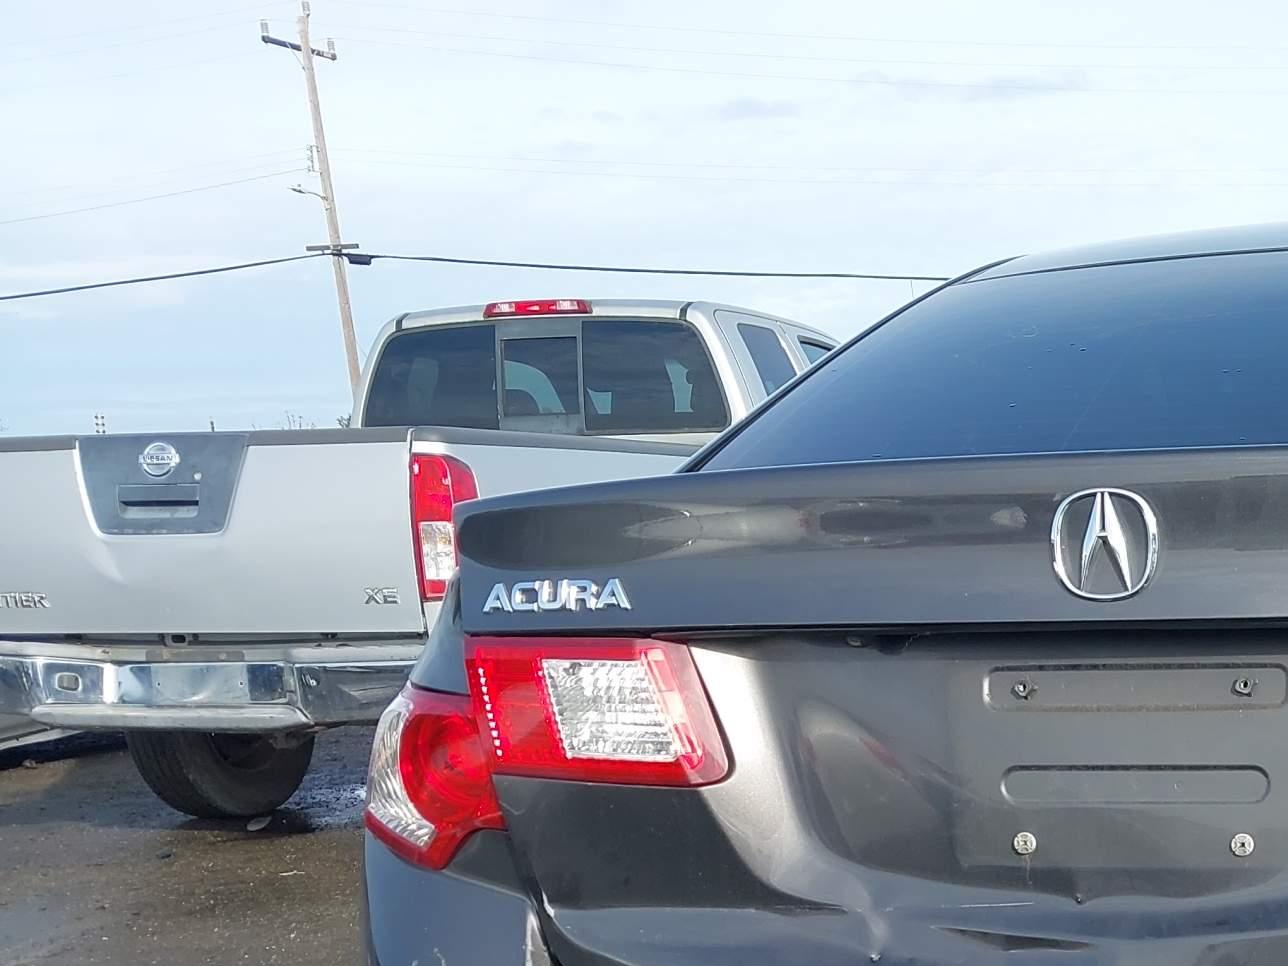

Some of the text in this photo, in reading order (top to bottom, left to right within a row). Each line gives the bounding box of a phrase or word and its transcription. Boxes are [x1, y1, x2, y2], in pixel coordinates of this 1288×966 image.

[0, 591, 50, 609] TIER
[363, 587, 400, 605] XE
[482, 578, 632, 614] ACURA
